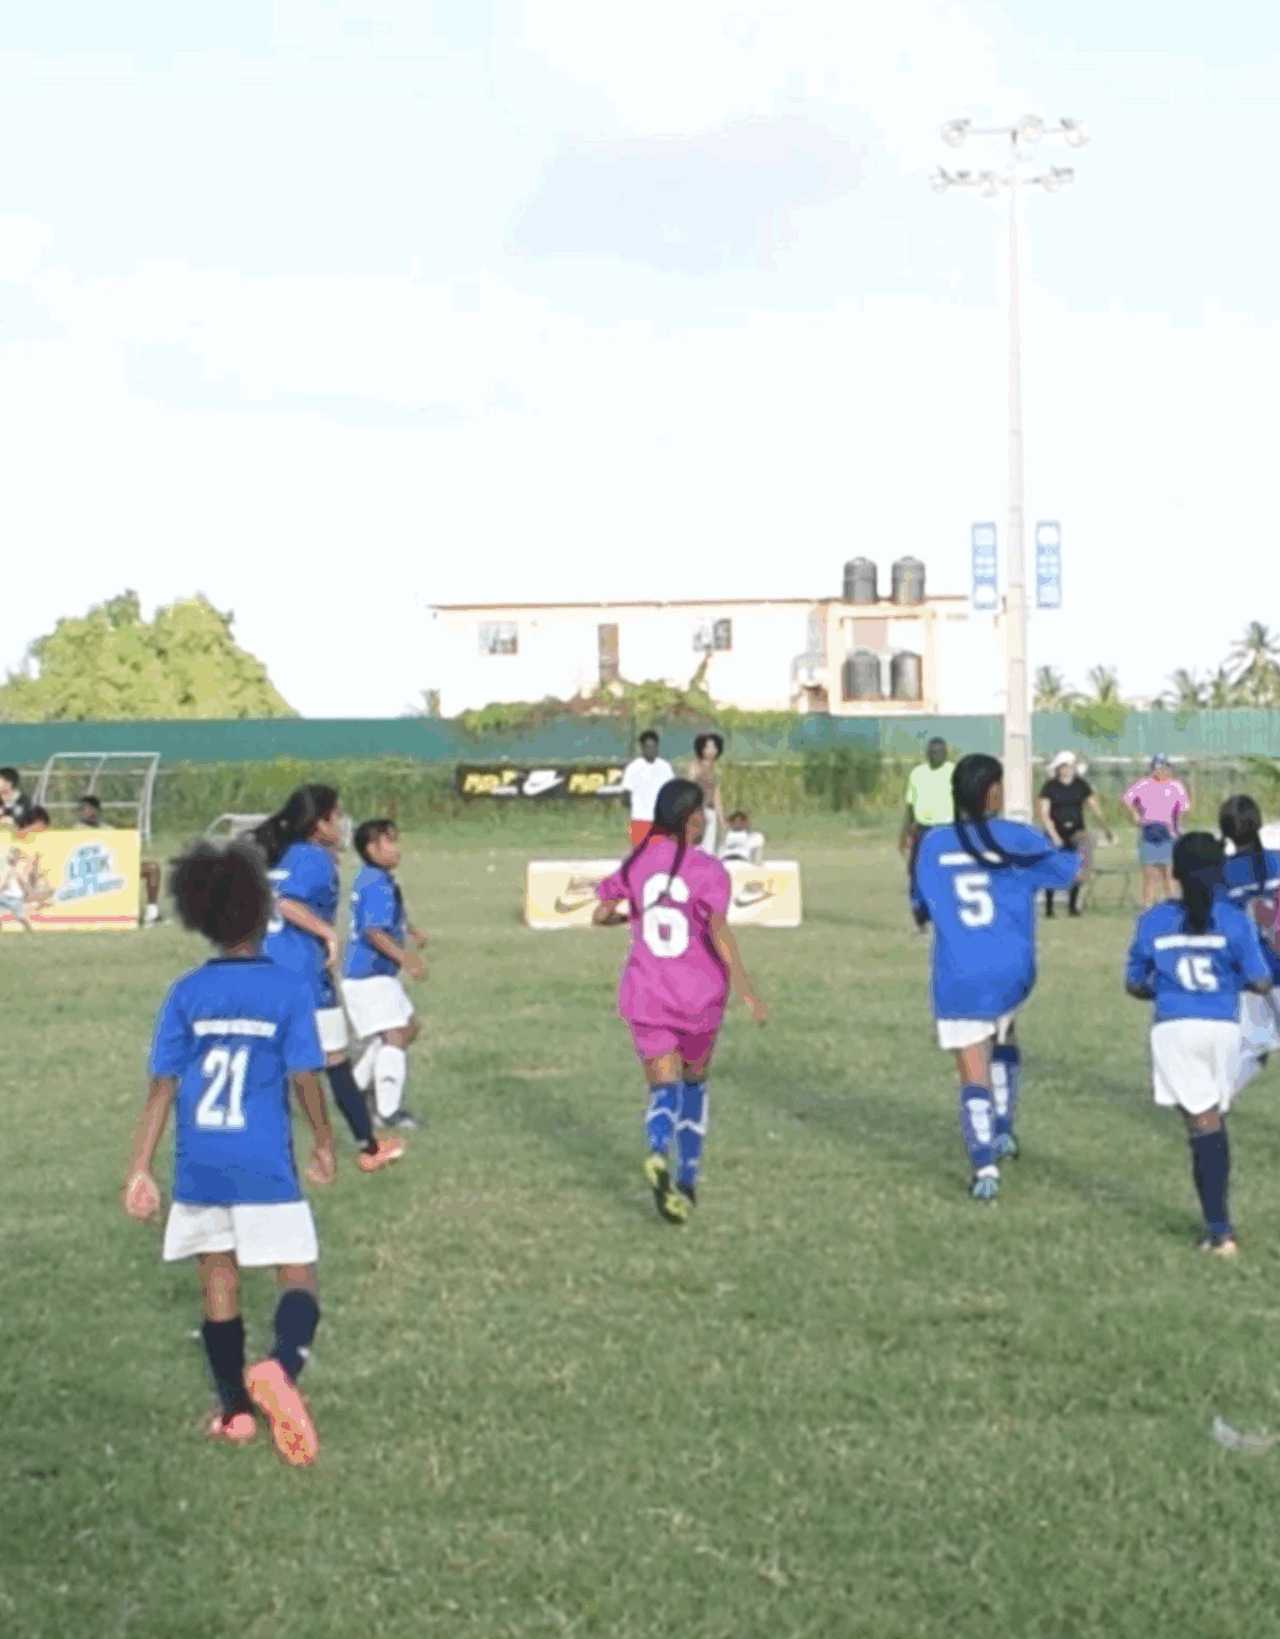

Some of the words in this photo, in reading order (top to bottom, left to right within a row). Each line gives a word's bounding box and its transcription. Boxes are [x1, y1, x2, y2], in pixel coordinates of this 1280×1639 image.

[643, 871, 690, 958] 6
[954, 872, 994, 927] 5
[1176, 955, 1219, 992] 15
[195, 1045, 250, 1130] 21
